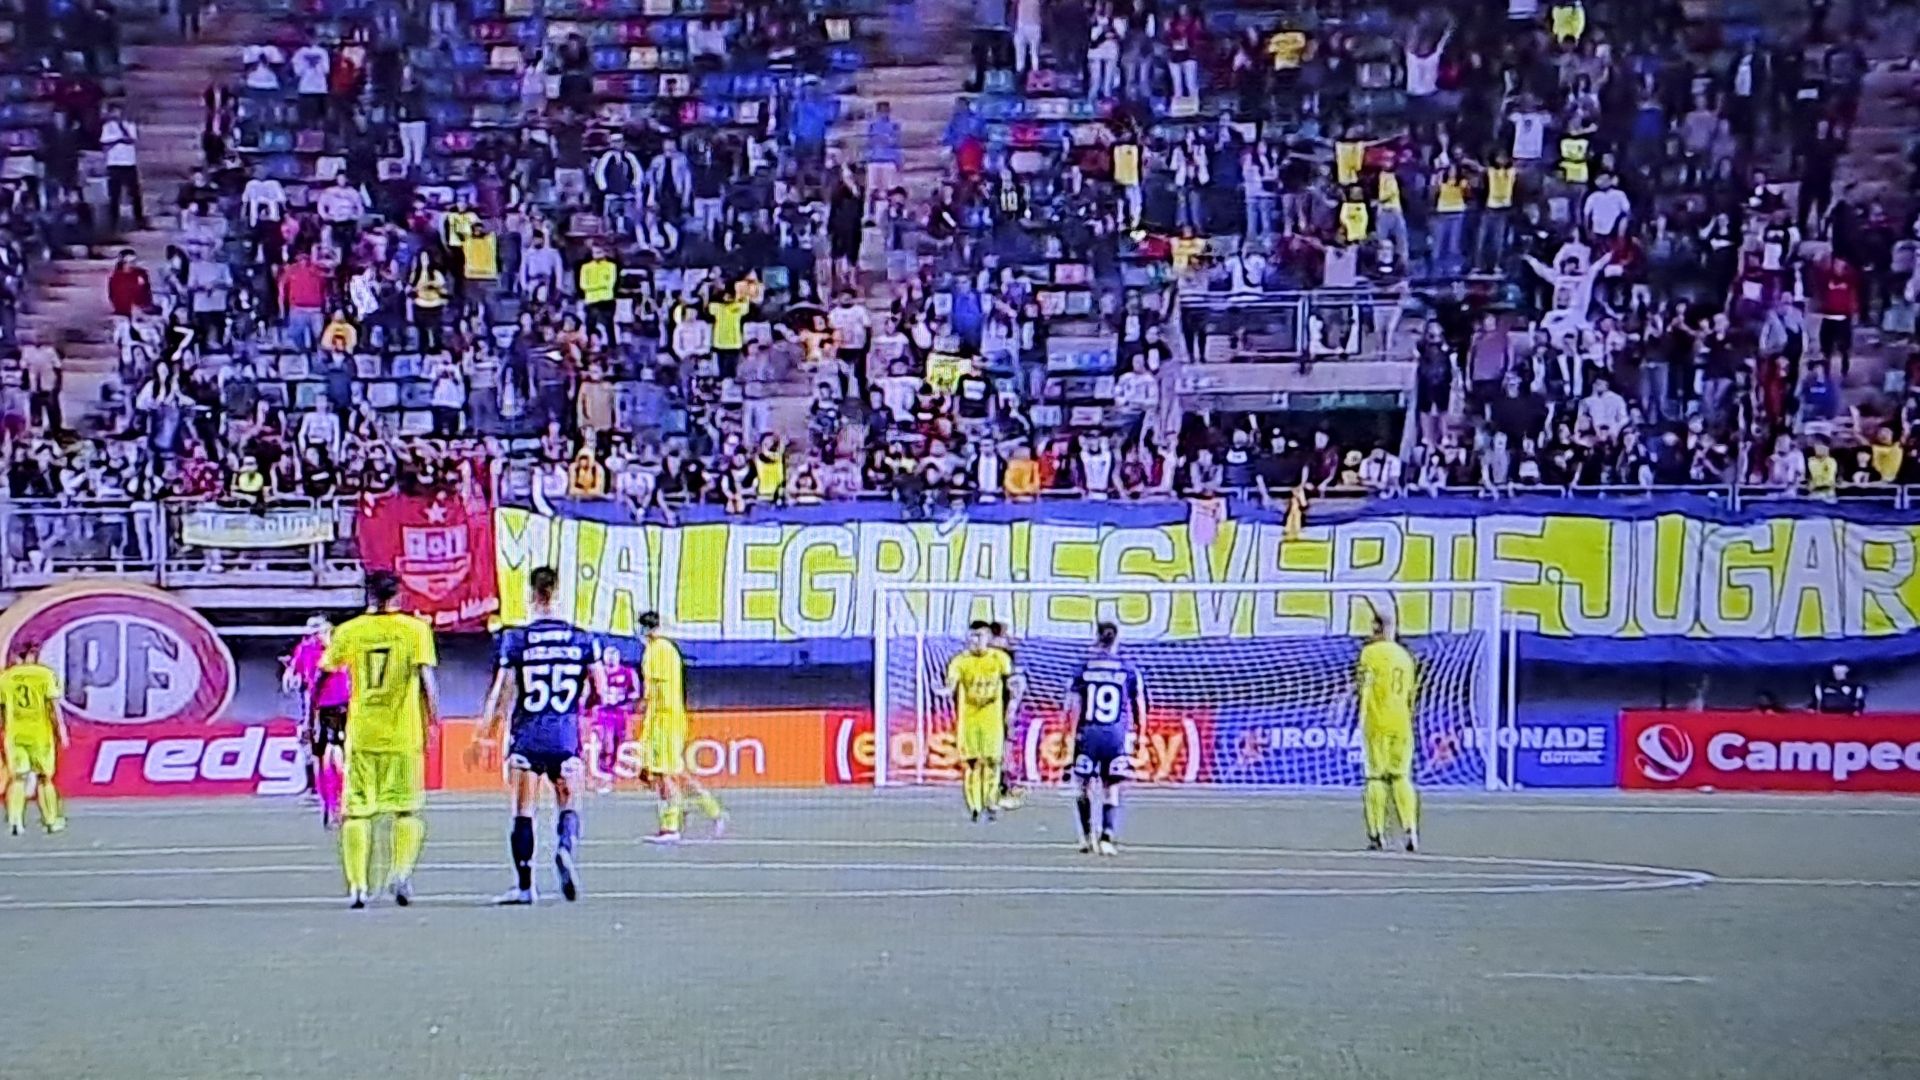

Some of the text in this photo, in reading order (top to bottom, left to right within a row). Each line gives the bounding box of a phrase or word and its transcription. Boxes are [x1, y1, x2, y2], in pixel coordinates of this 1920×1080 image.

[1026, 520, 1176, 640] ES
[1188, 515, 1547, 637] VERTE
[1559, 514, 1919, 638] JUGAR
[16, 684, 31, 708] 3
[522, 664, 583, 713] 55
[1086, 683, 1121, 723] 19
[90, 726, 308, 795] redg
